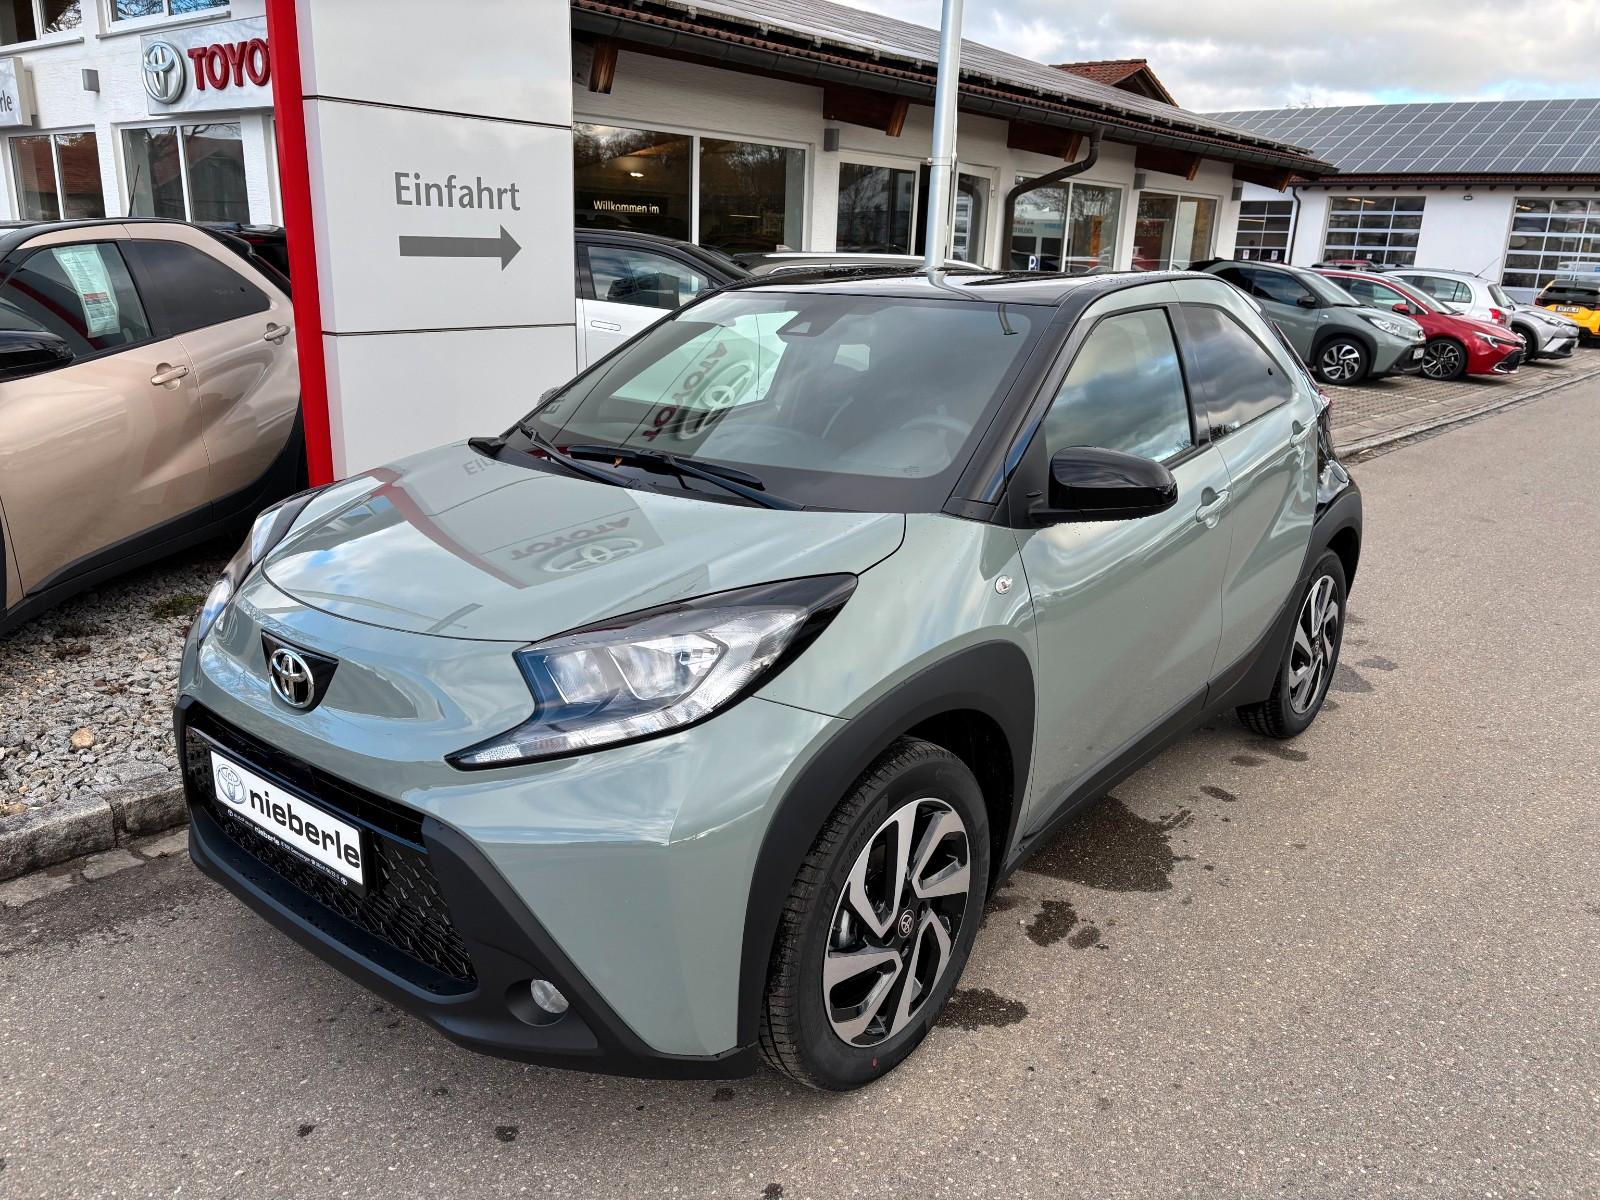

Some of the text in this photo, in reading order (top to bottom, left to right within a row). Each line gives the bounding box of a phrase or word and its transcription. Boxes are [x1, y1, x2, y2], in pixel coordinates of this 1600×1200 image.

[187, 38, 270, 91] TOYO
[0, 90, 12, 112] rle
[394, 171, 520, 211] Einfahrt
[593, 200, 660, 214] Willkommen im
[249, 788, 361, 869] nieberle
